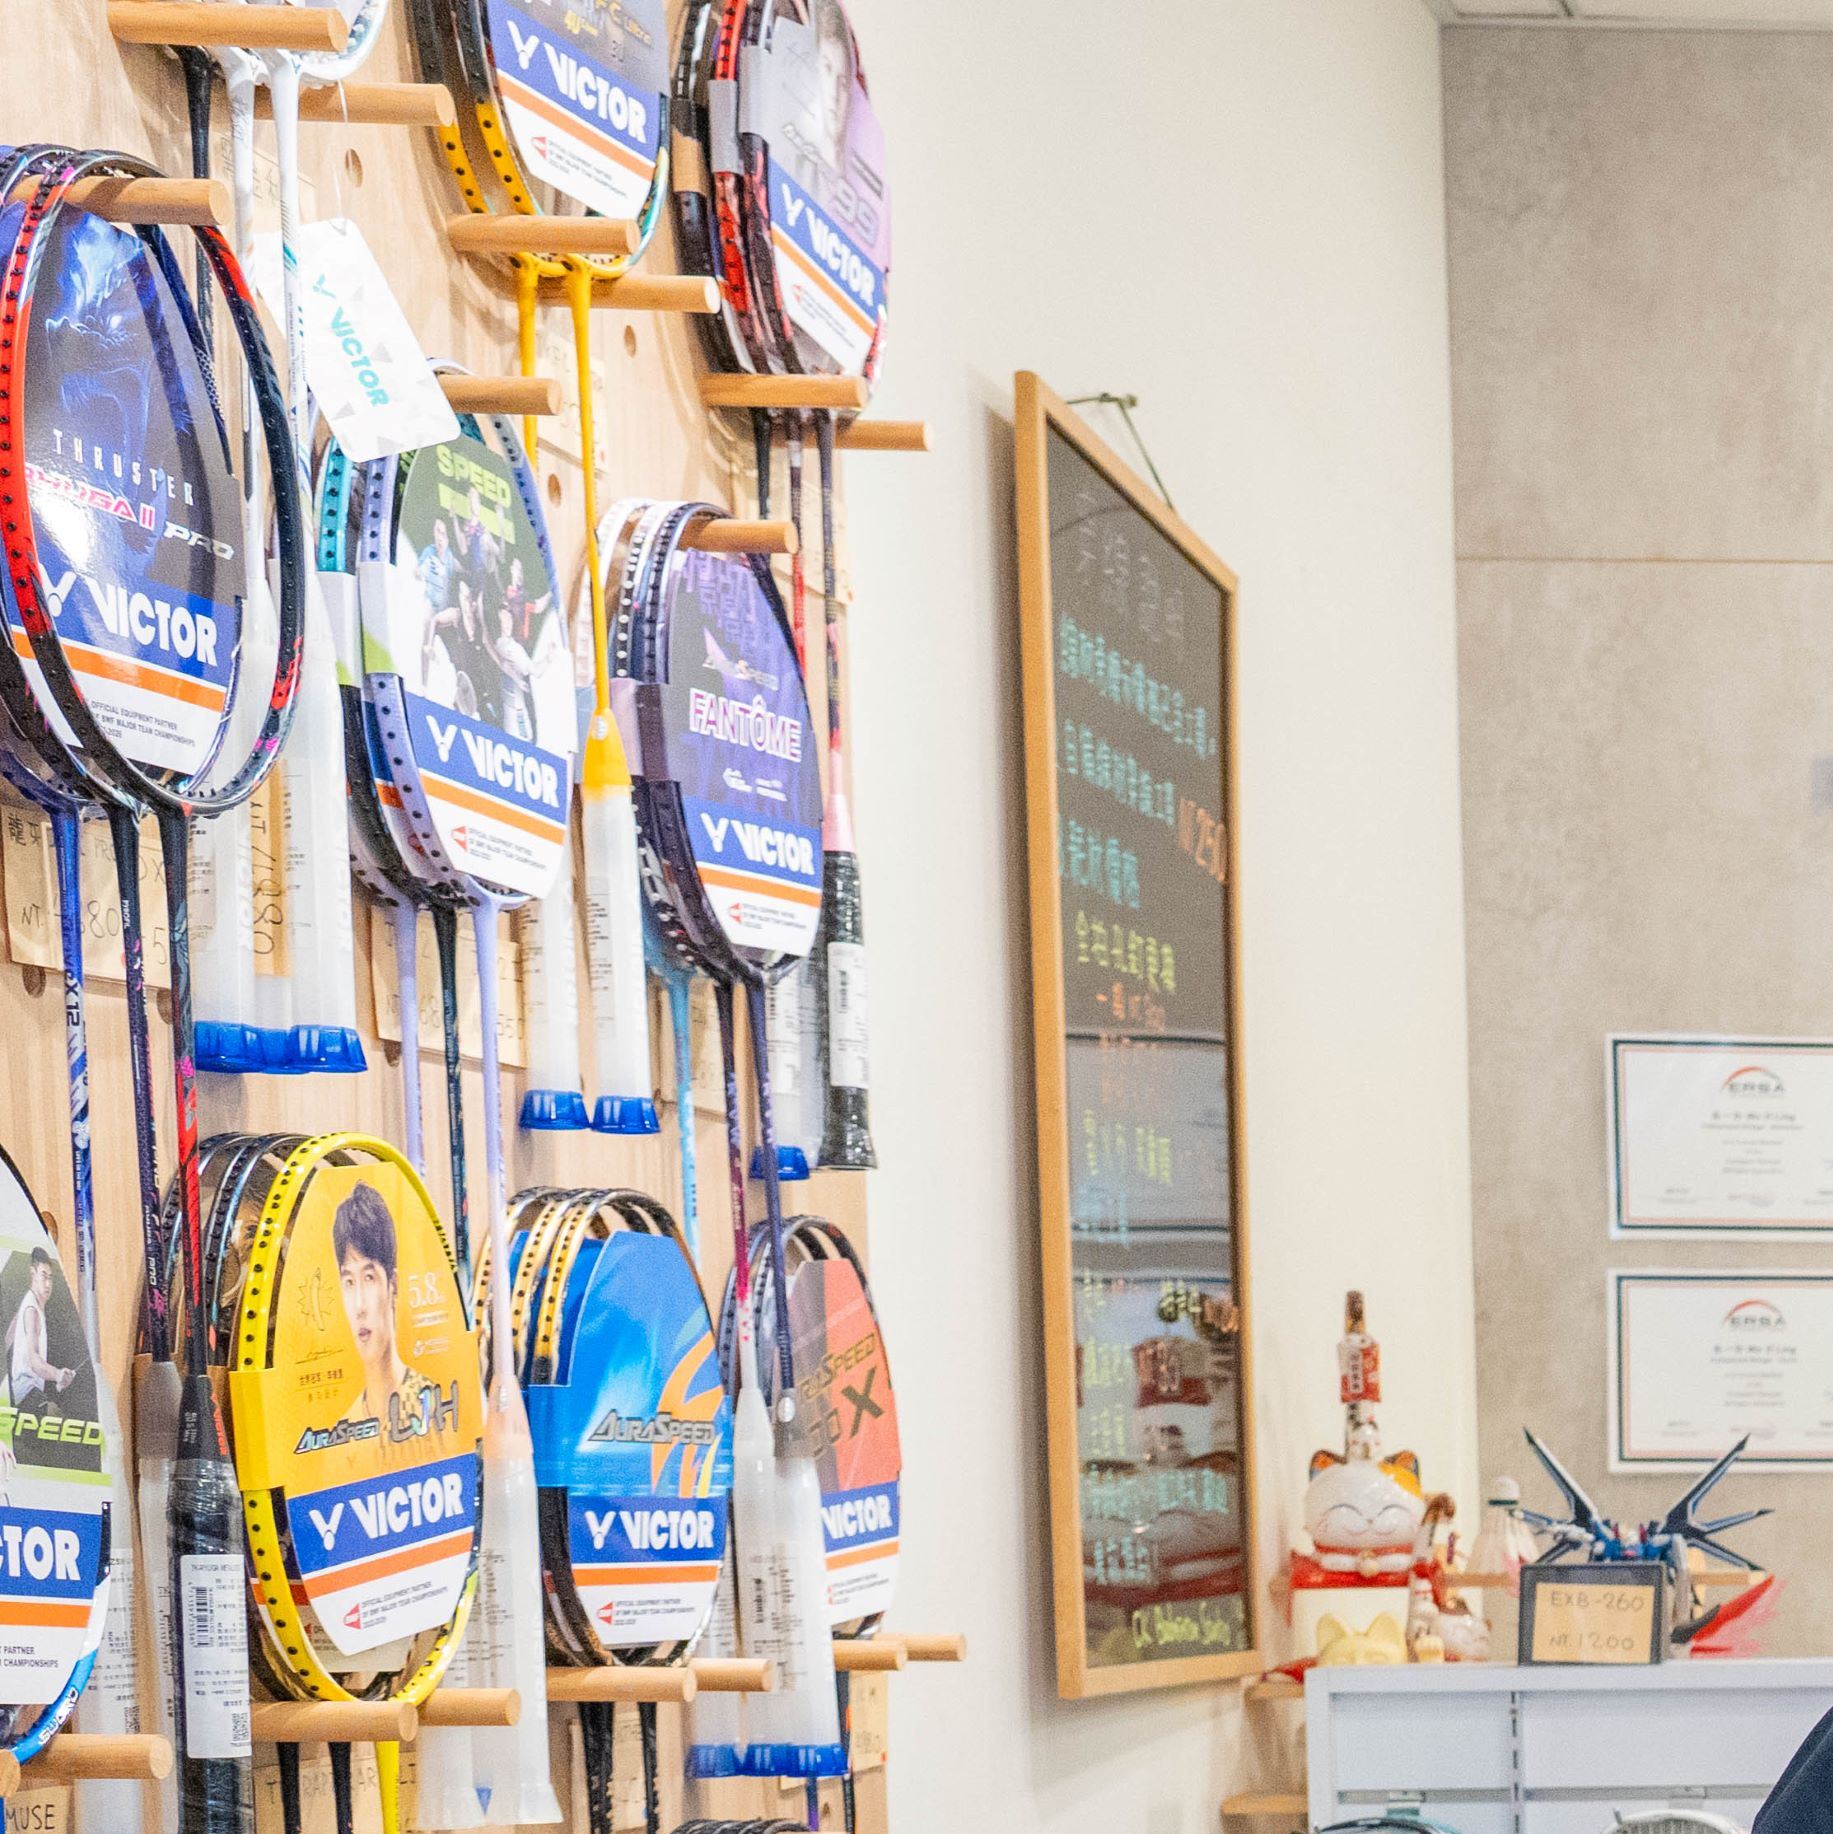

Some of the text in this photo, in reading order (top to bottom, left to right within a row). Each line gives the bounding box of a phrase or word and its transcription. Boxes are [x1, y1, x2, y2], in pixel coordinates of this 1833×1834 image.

[544, 42, 647, 144] VICTOR
[805, 206, 875, 306] VICTOR
[331, 306, 390, 407] VICTOR
[53, 428, 194, 506] THRUSTER
[436, 444, 512, 509] SPEED
[164, 521, 235, 560] PRO
[84, 577, 218, 667] VICTOR
[689, 687, 802, 763] FANTÔME
[461, 729, 560, 809] VICTOR
[731, 819, 815, 876] VICTOR
[0, 1405, 103, 1446] SPEED
[294, 1416, 380, 1455] AURASPEED
[588, 1409, 718, 1445] AURASPEED
[350, 1472, 464, 1539] VICTOR
[620, 1510, 716, 1550] VICTOR
[820, 1494, 893, 1541] VICTOR
[0, 1524, 81, 1581] TOR
[4, 1658, 58, 1668] CHAMPIONSHIPS
[5, 1646, 35, 1656] PARTNER
